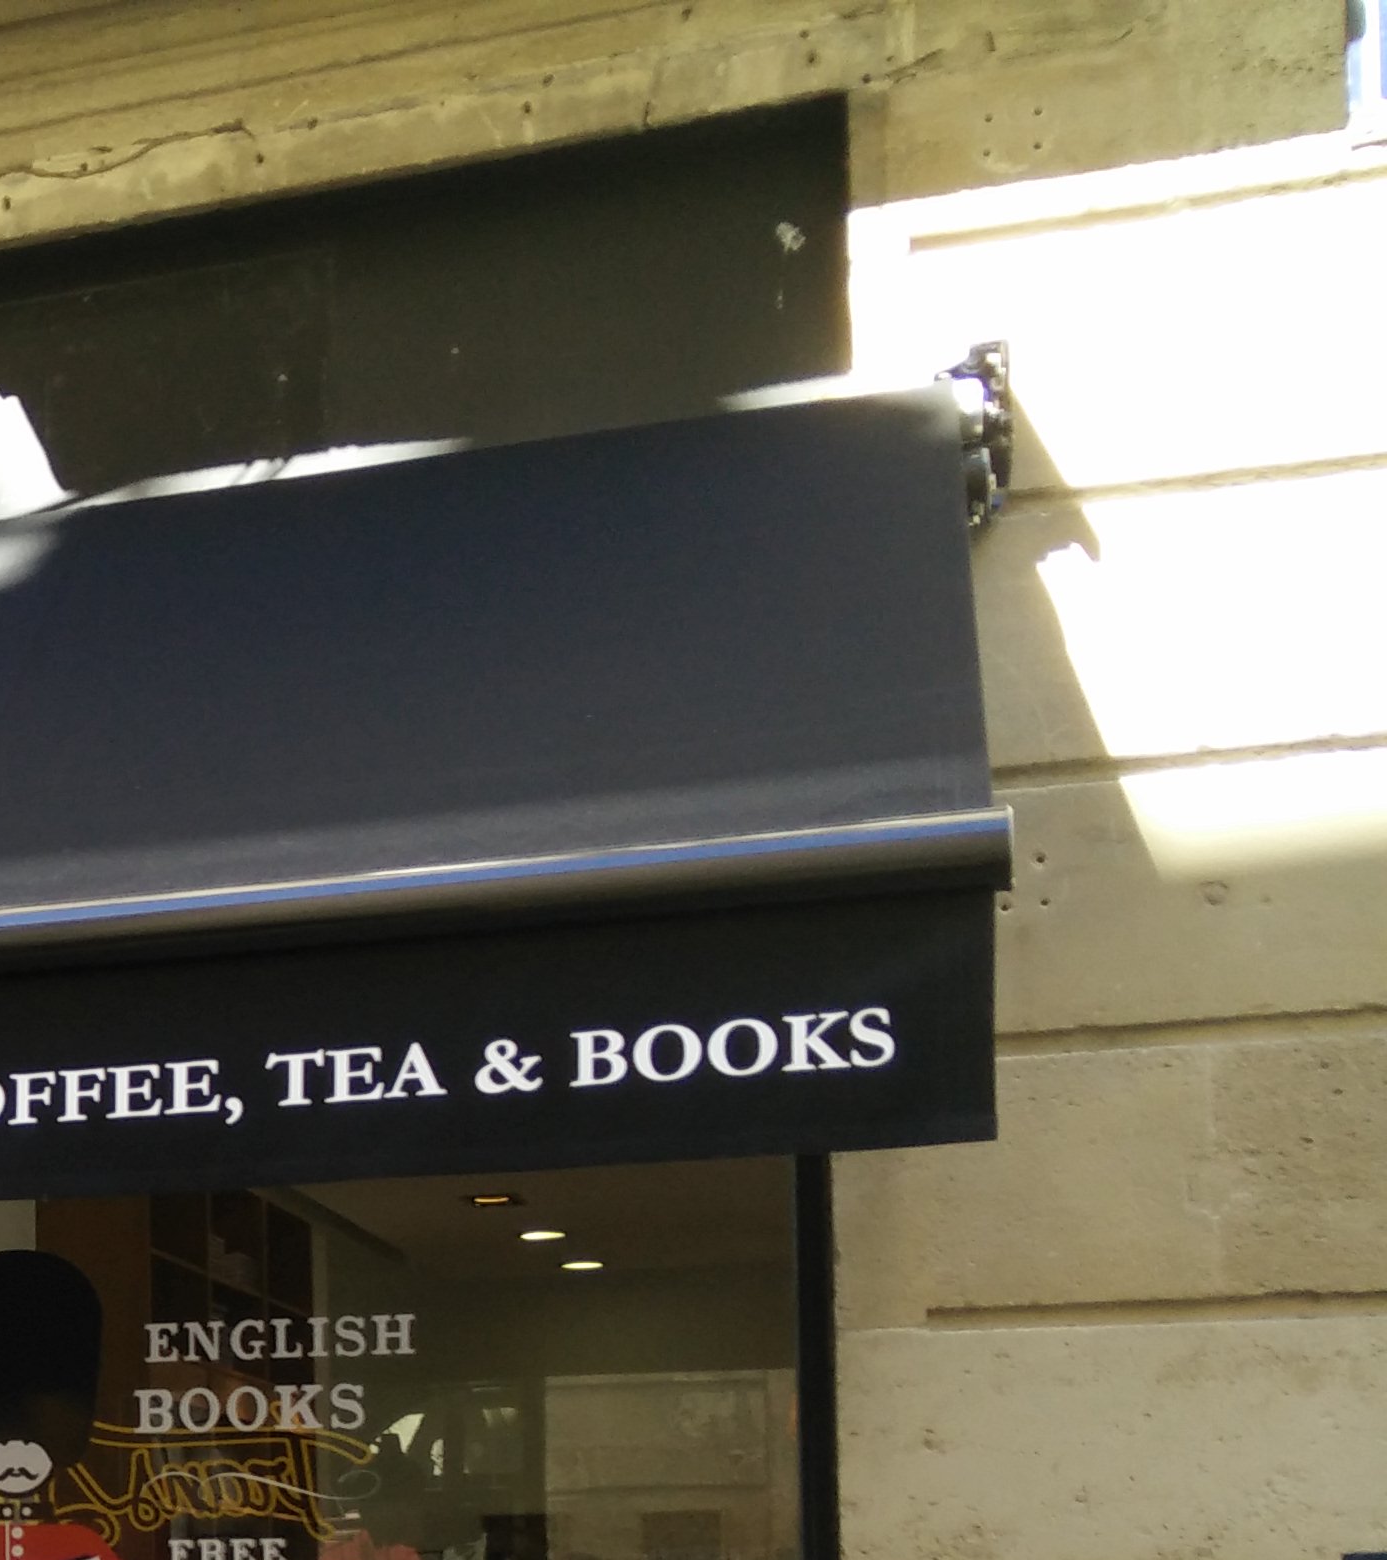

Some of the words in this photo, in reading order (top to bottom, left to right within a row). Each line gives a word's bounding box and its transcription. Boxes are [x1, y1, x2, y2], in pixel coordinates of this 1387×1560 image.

[266, 1041, 447, 1108] TEA
[473, 1037, 544, 1095] &
[570, 1007, 896, 1087] BOOKS
[144, 1312, 417, 1364] ENGLISH
[133, 1382, 366, 1436] BOOKS
